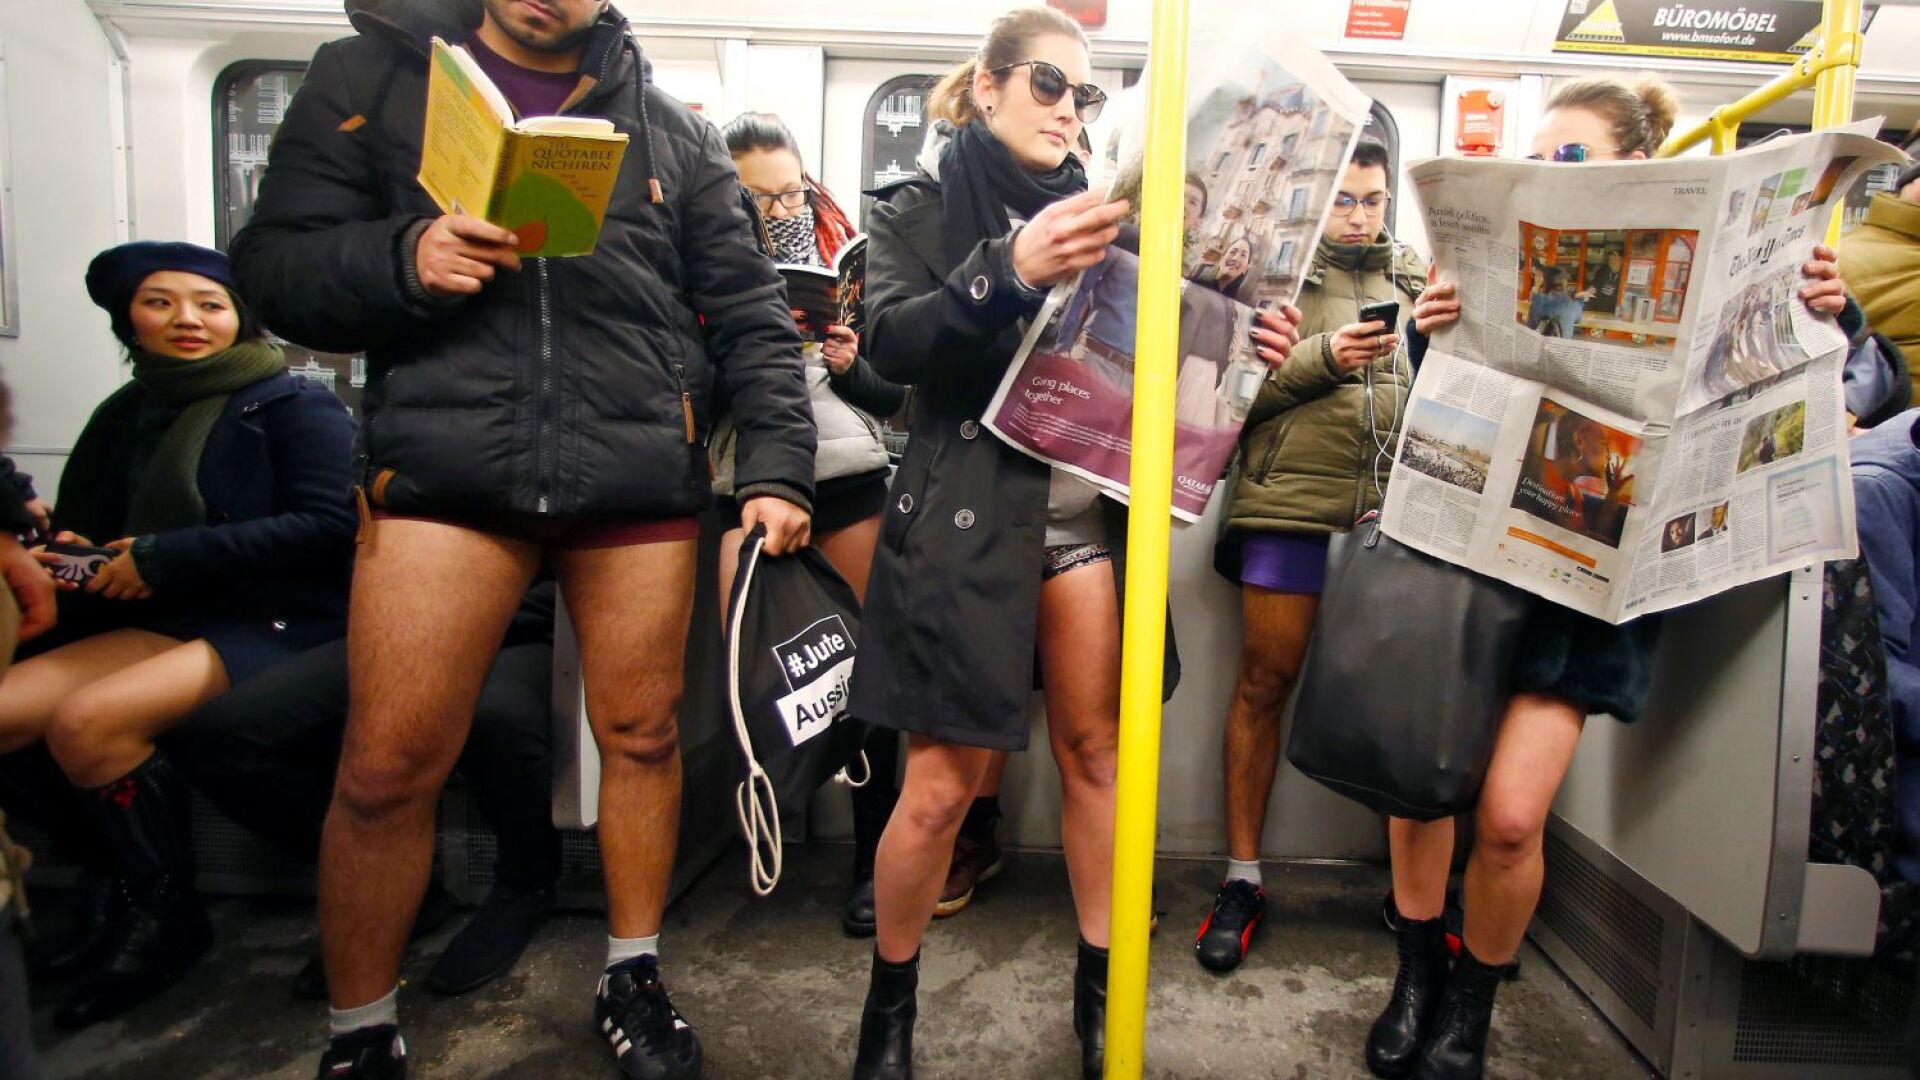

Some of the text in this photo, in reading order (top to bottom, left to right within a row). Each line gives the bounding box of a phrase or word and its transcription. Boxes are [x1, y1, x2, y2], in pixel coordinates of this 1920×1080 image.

[1653, 3, 1778, 33] BÜROMÖBEL
[1662, 30, 1757, 46] www.bmsofort.de
[532, 147, 615, 160] QUOTABLE
[531, 159, 611, 171] NICHIREN
[1672, 186, 1708, 195] TRAVEL
[1024, 388, 1065, 406] together
[1057, 381, 1092, 400] places
[788, 633, 846, 678] #Jute
